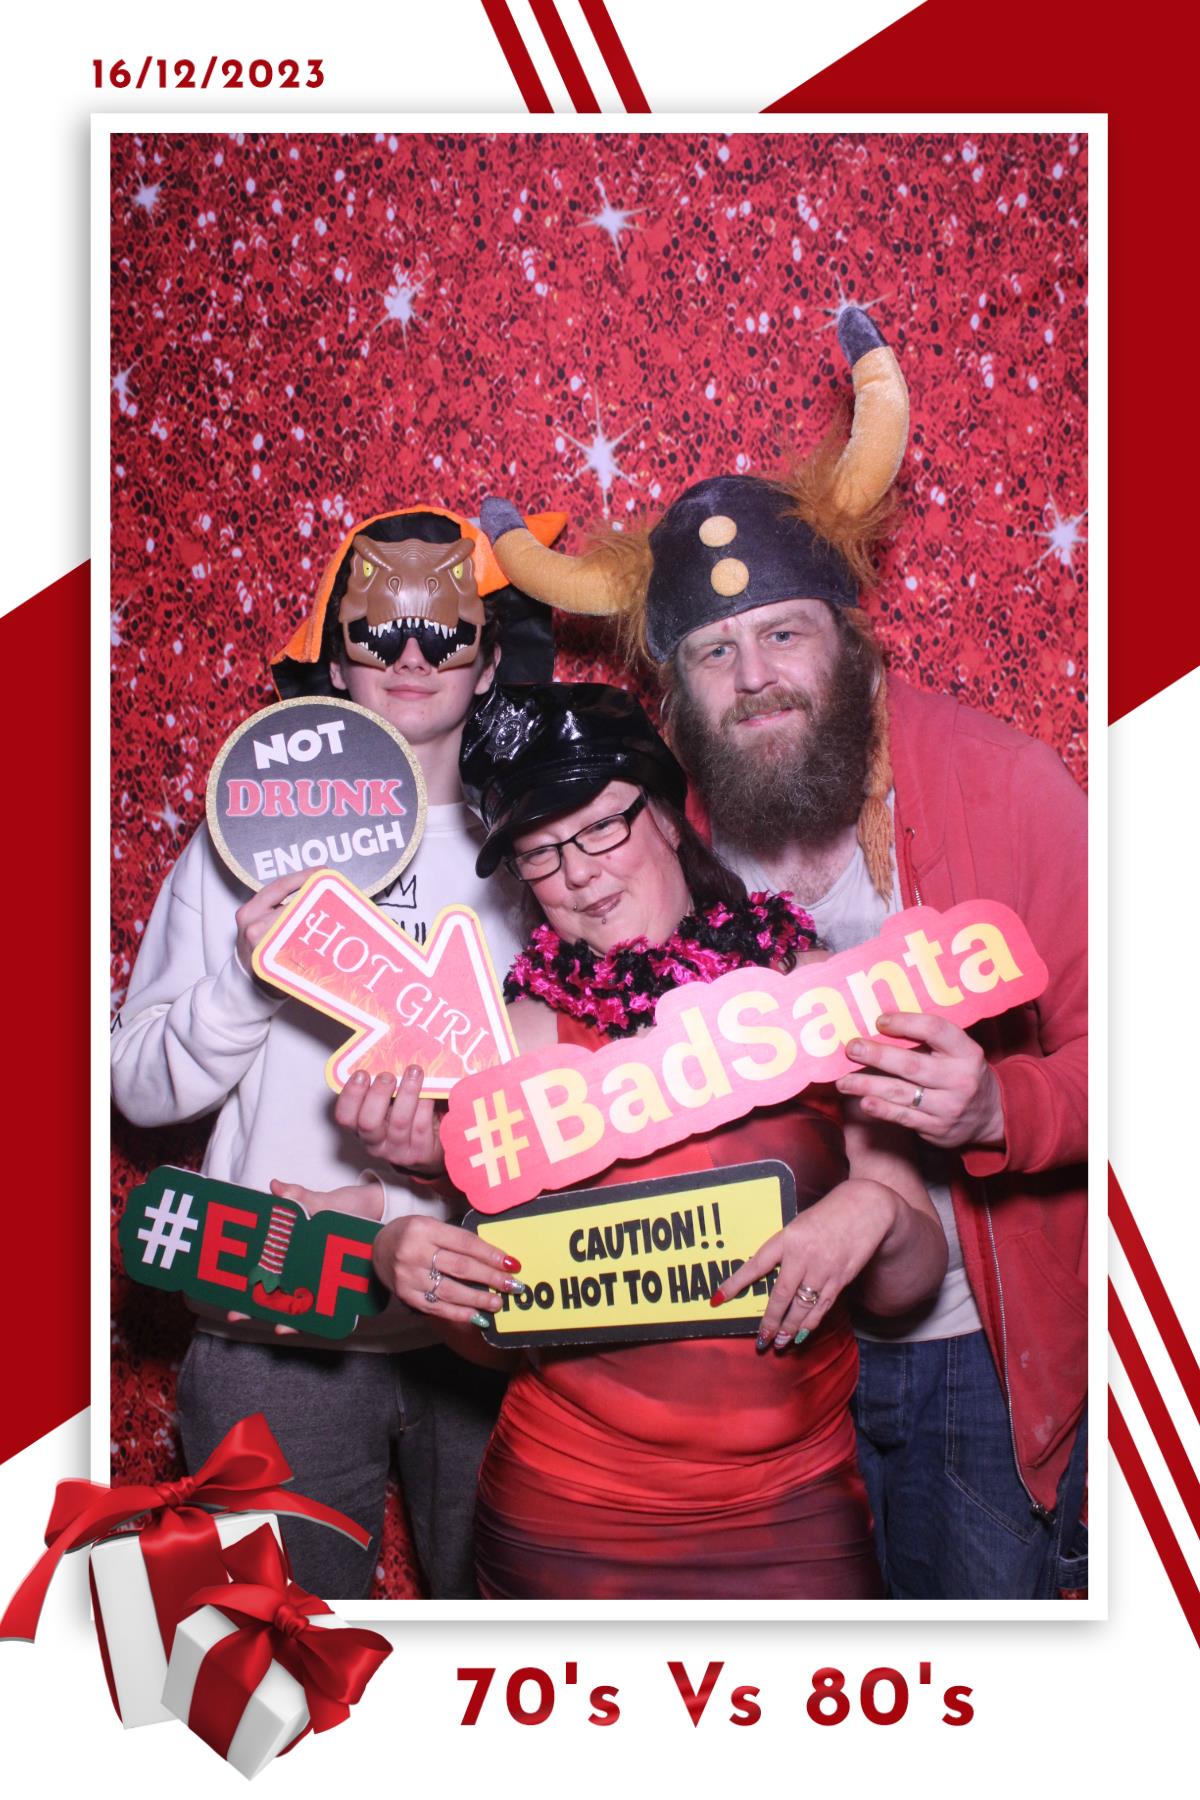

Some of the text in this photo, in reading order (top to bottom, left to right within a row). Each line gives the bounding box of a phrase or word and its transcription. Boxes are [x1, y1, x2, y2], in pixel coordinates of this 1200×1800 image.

[253, 720, 346, 769] NOT
[225, 779, 408, 818] DRUNK
[253, 820, 405, 881] ENOUGH
[299, 909, 491, 1075] HOT GIRL
[463, 921, 1024, 1189] #BadSanta
[568, 1202, 725, 1263] CAUTION!!
[560, 1274, 618, 1310] HOT
[623, 1270, 663, 1305] TO
